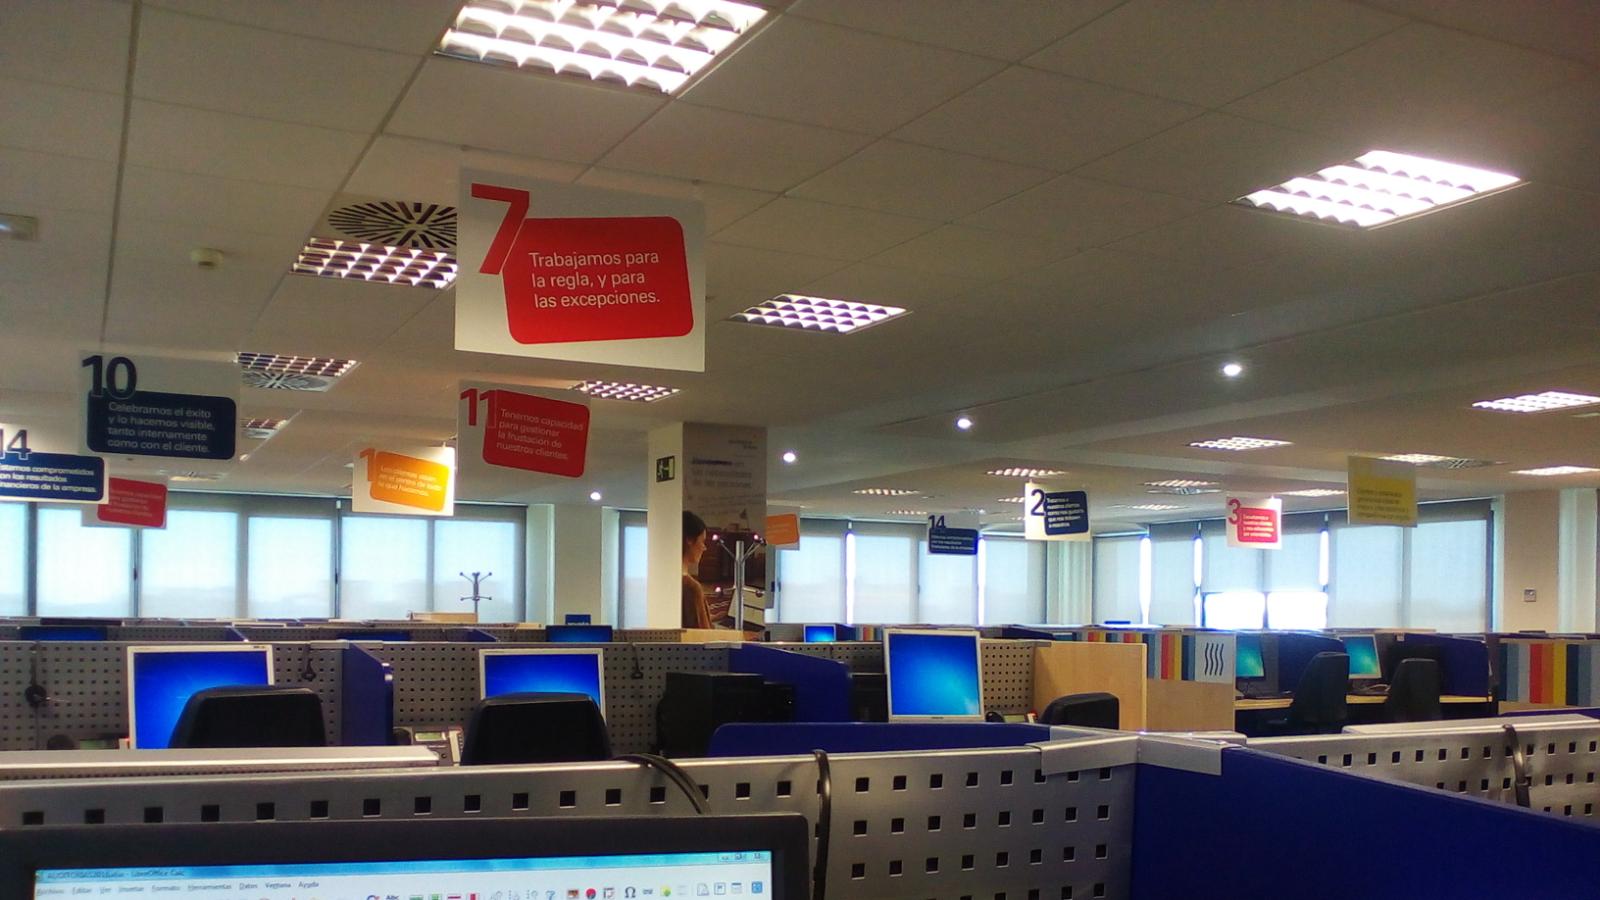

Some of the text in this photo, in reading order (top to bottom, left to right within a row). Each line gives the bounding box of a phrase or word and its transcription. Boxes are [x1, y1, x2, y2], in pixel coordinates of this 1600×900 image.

[472, 183, 530, 275] 7
[529, 251, 659, 269] Trabajamos para
[532, 271, 645, 290] la regla, y para
[534, 290, 660, 308] las excepciones.
[82, 355, 137, 399] 10
[108, 402, 172, 416] Celebramos
[174, 407, 183, 417] el
[460, 388, 496, 428] 11
[108, 415, 215, 432] y lo hacemos visible,
[501, 408, 584, 431] Tenemos capacidad
[108, 426, 207, 441] tanto internamente
[499, 421, 560, 437] para gestionar
[107, 438, 138, 448] como
[140, 440, 160, 450] con
[163, 440, 172, 450] el
[496, 442, 533, 455] nuestros
[498, 430, 506, 439] la
[551, 440, 562, 449] de
[0, 464, 31, 473] stamos
[1030, 489, 1046, 516] 2
[1228, 498, 1240, 525] 3
[928, 514, 946, 530] 14
